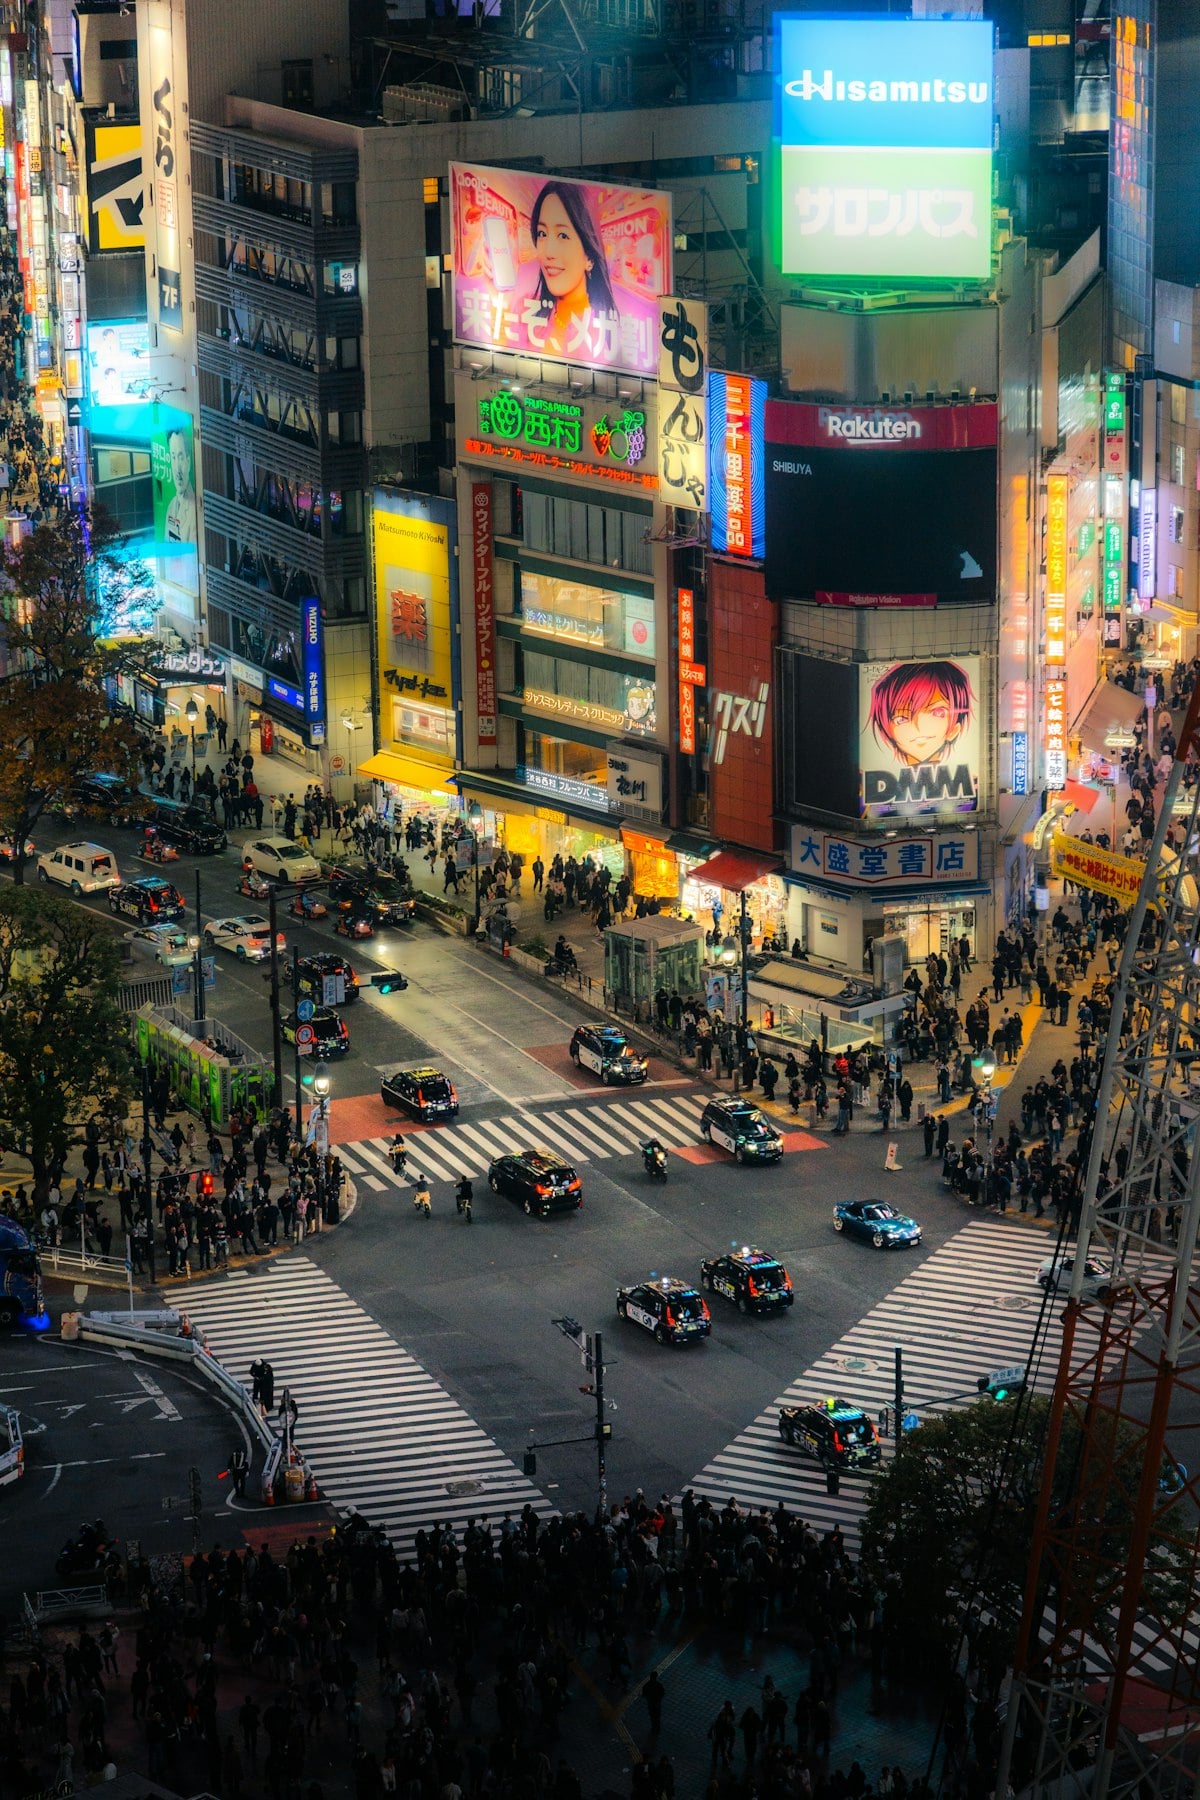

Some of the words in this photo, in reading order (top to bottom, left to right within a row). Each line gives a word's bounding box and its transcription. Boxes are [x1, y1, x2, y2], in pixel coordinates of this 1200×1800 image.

[785, 69, 988, 103] Hisamitsu
[795, 187, 978, 239] サロンパス
[162, 285, 178, 309] 7F
[461, 288, 658, 366] 来たぞ、メガ割
[479, 400, 490, 434] 渋谷
[661, 301, 705, 507] もんじゃ
[524, 411, 582, 453] 西村
[828, 414, 921, 440] Rakuten
[726, 384, 745, 548] 三千里薬品
[773, 460, 812, 475] SHIBUYA
[379, 523, 418, 539] Matsumoto
[474, 509, 493, 657] ウィンターフルーツギフト
[848, 595, 878, 606] Rakuten
[309, 606, 318, 644] MIZUHO
[390, 587, 427, 641] 薬
[1047, 592, 1065, 657] 三千里
[714, 682, 769, 766] クスリ
[864, 764, 974, 804] DMM
[800, 836, 965, 876] 大盛堂書店
[713, 1278, 736, 1301] S.RIDE
[793, 1430, 820, 1457] S.RIDE
